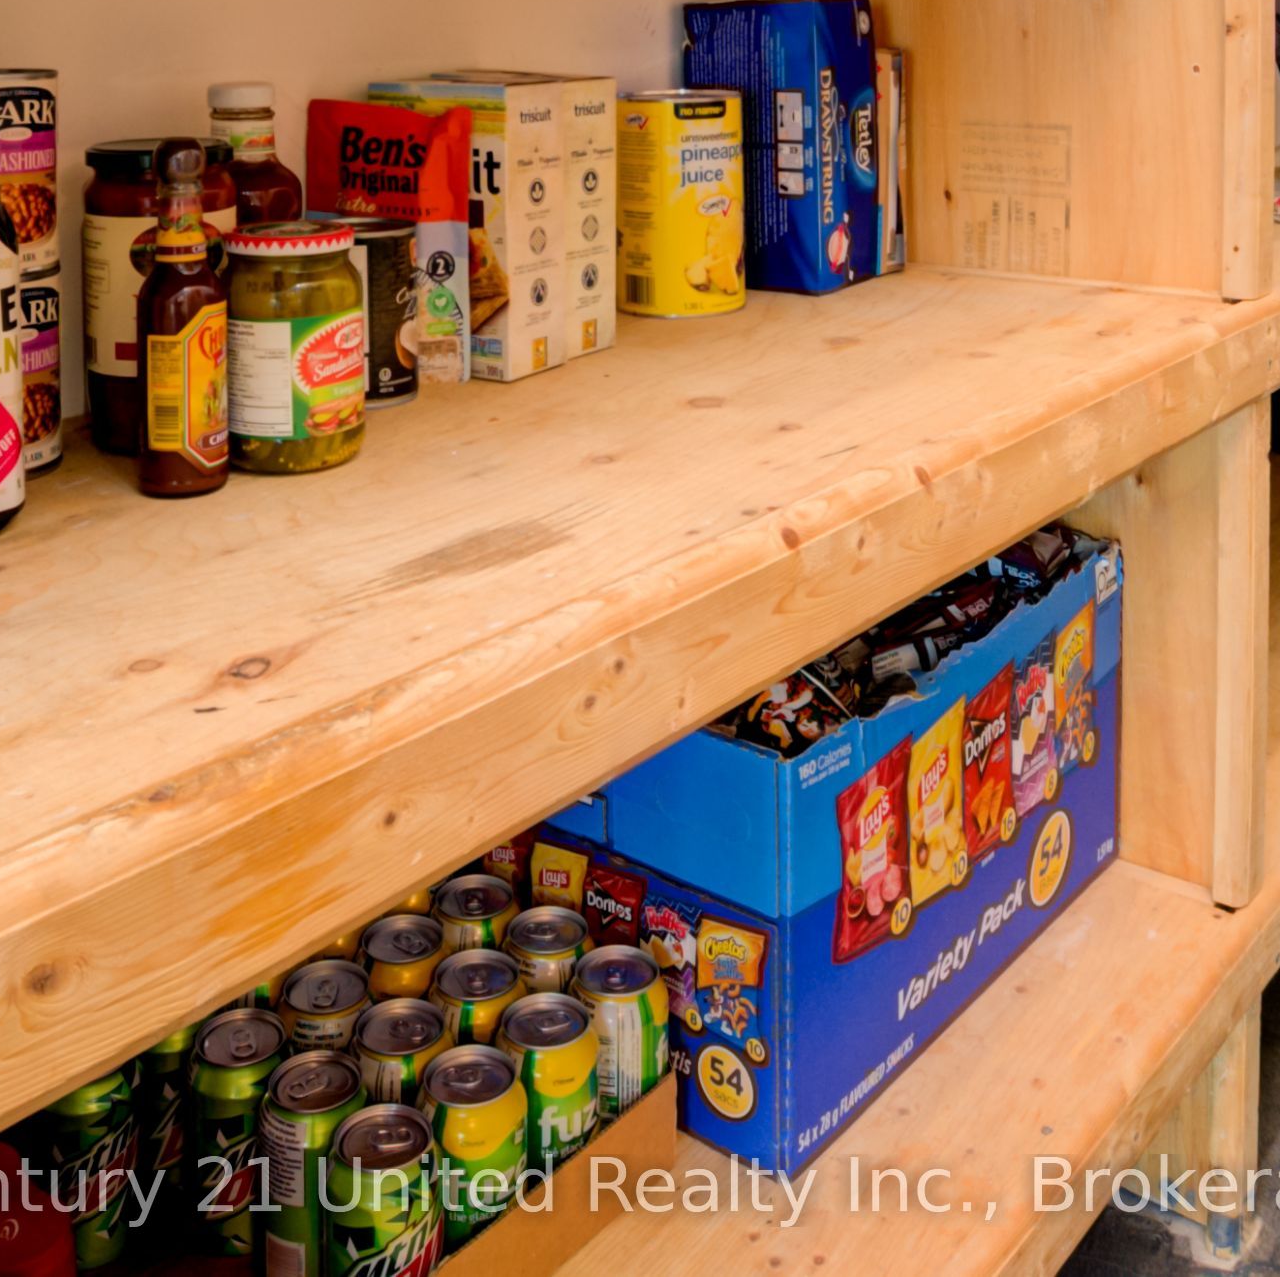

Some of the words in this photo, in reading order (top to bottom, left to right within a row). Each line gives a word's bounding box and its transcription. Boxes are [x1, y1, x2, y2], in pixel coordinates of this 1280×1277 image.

[520, 107, 552, 124] triscuit
[574, 101, 606, 117] triscuit
[679, 107, 694, 116] no
[695, 106, 720, 116] name
[340, 125, 428, 169] Ben's
[820, 69, 835, 225] DRAWSTRING
[854, 103, 872, 172] Tetley
[680, 167, 725, 188] juice
[435, 257, 446, 274] 2
[920, 752, 948, 801] Lay's
[859, 792, 890, 847] Lay's
[1038, 830, 1063, 876] 54
[541, 867, 568, 889] Lay's
[586, 890, 632, 922] Doritos
[893, 904, 910, 929] 10
[704, 936, 746, 961] Cheetos
[897, 927, 976, 1021] Variety
[977, 878, 1027, 947] Pack
[749, 1041, 763, 1057] 10
[709, 1055, 744, 1097] 54
[797, 1131, 811, 1153] 54
